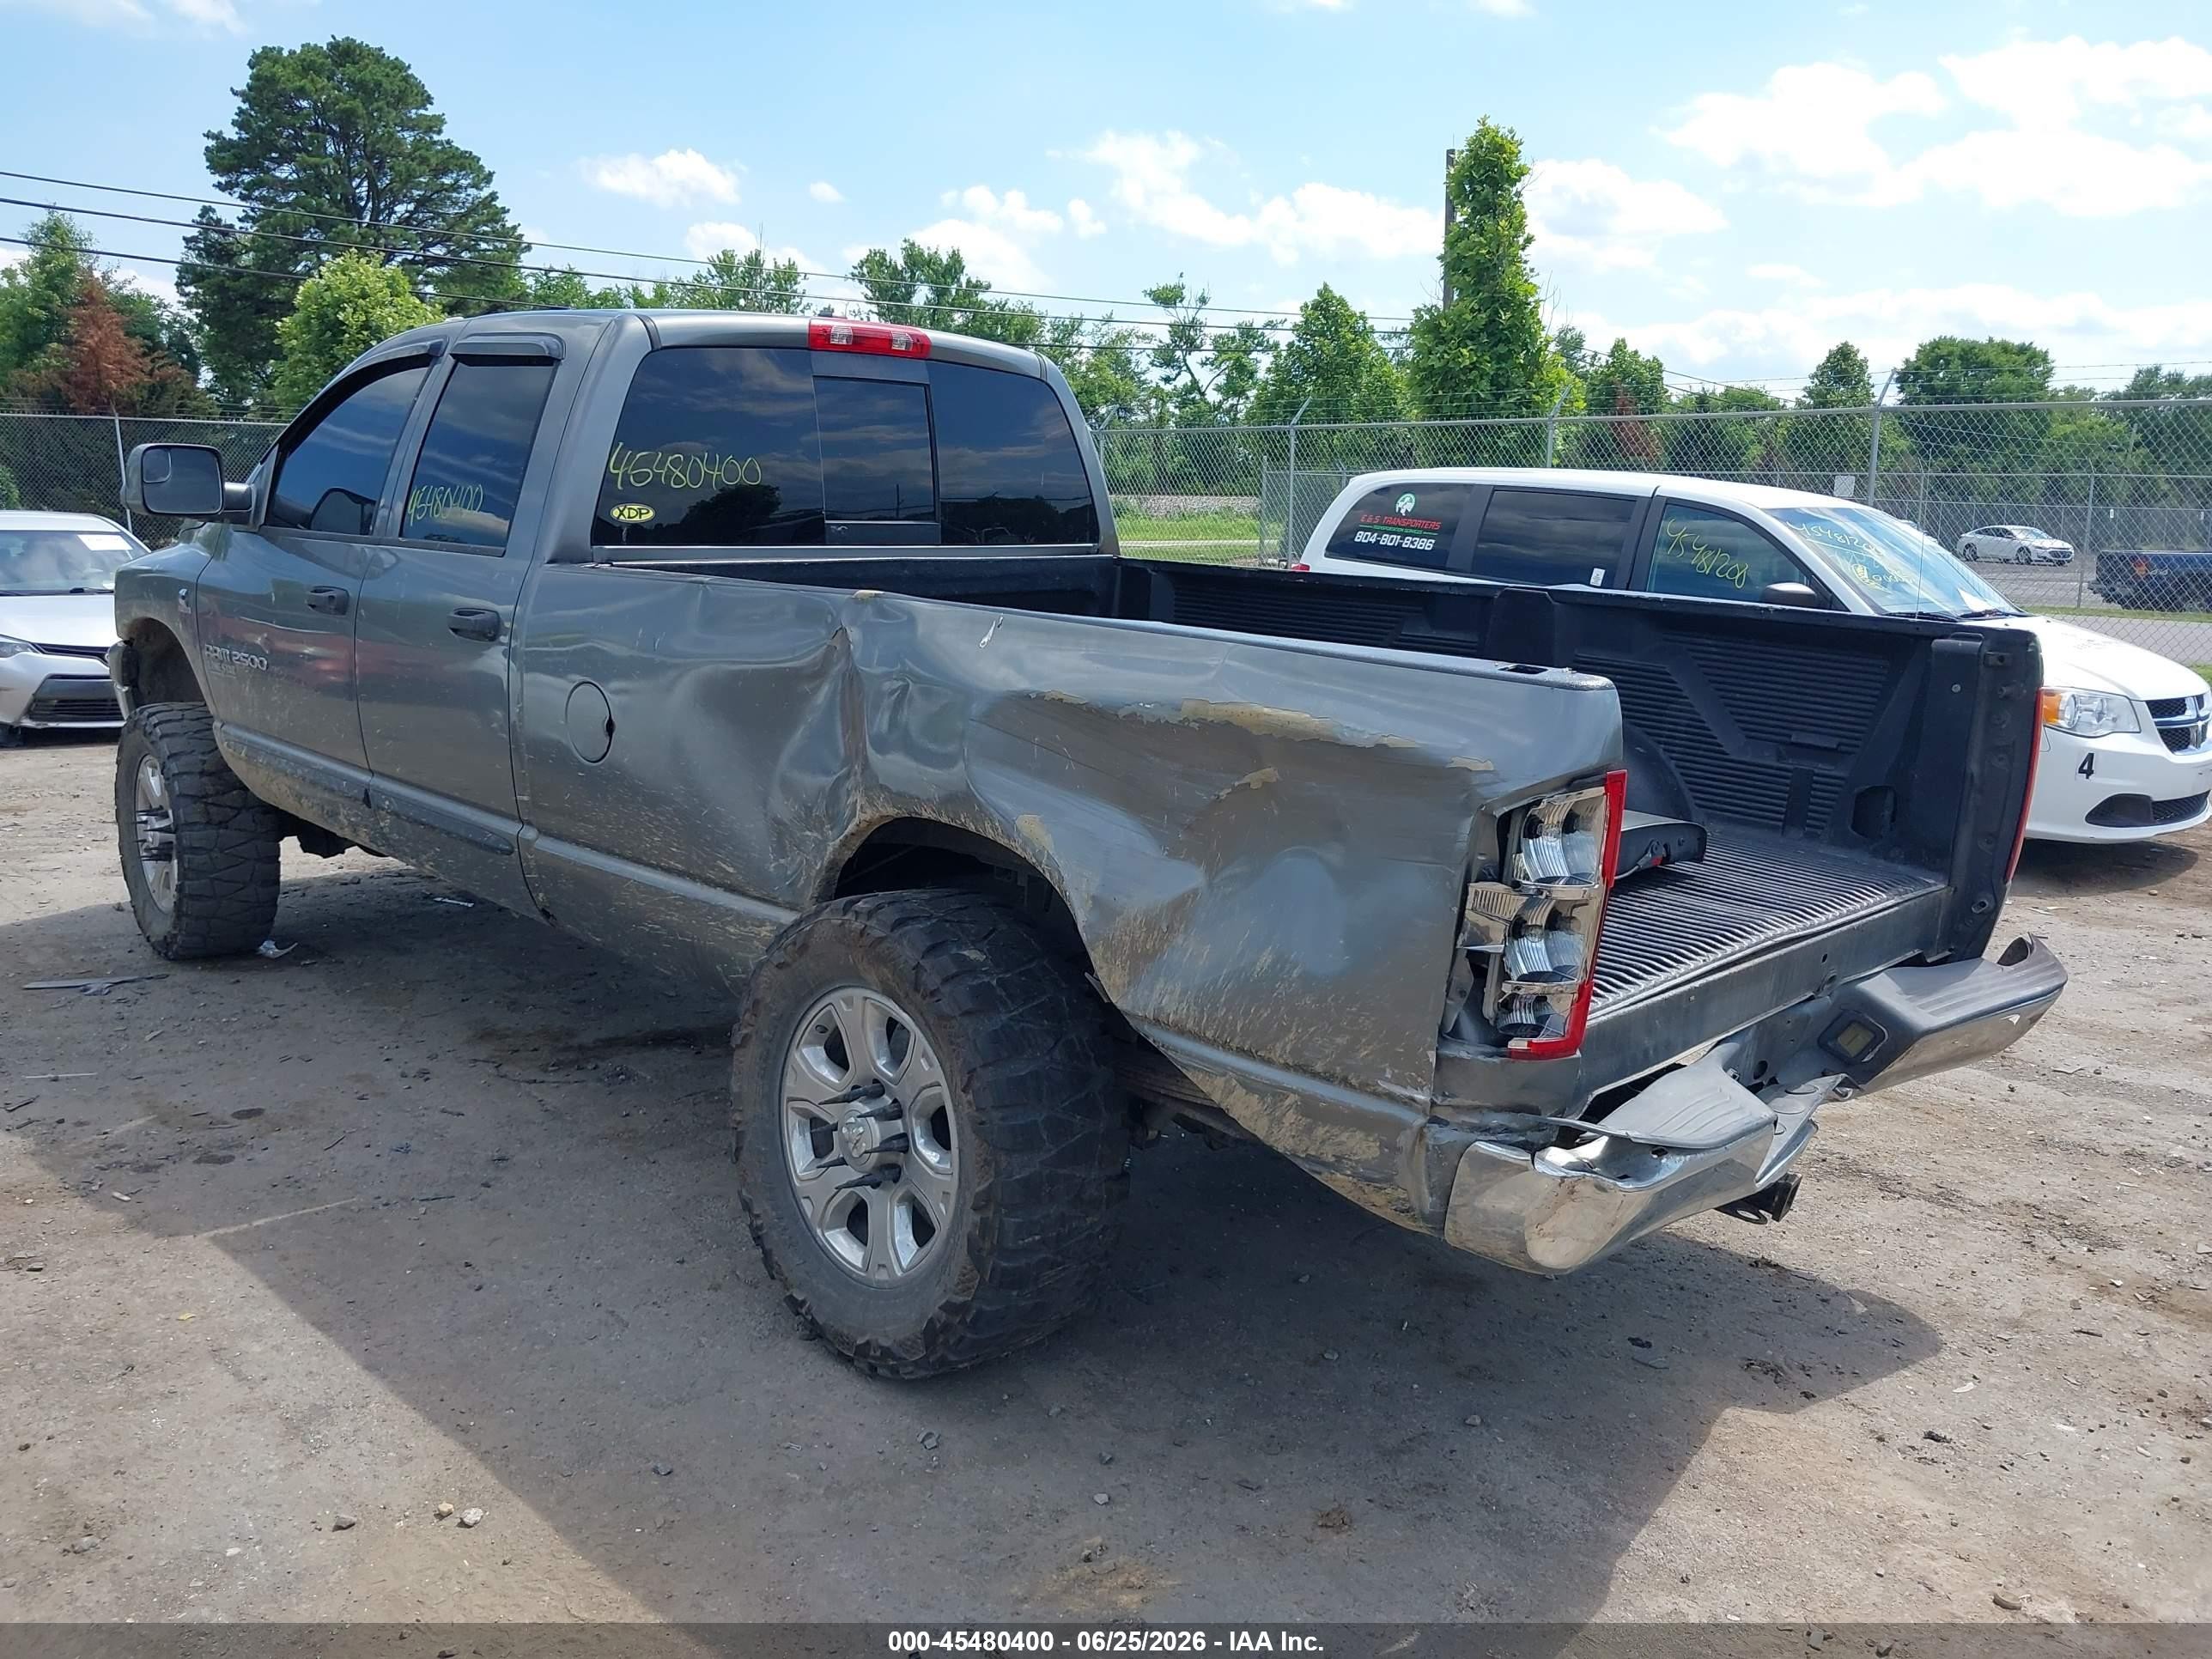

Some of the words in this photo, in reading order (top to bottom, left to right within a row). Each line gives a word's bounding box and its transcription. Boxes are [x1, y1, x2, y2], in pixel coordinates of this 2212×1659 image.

[617, 505, 650, 520] XDP
[1382, 516, 1442, 530] TRANSPORTERS
[1354, 531, 1436, 550] 804-801-8386
[205, 644, 231, 661] RAM
[232, 651, 268, 671] 2500
[2078, 752, 2095, 780] 4
